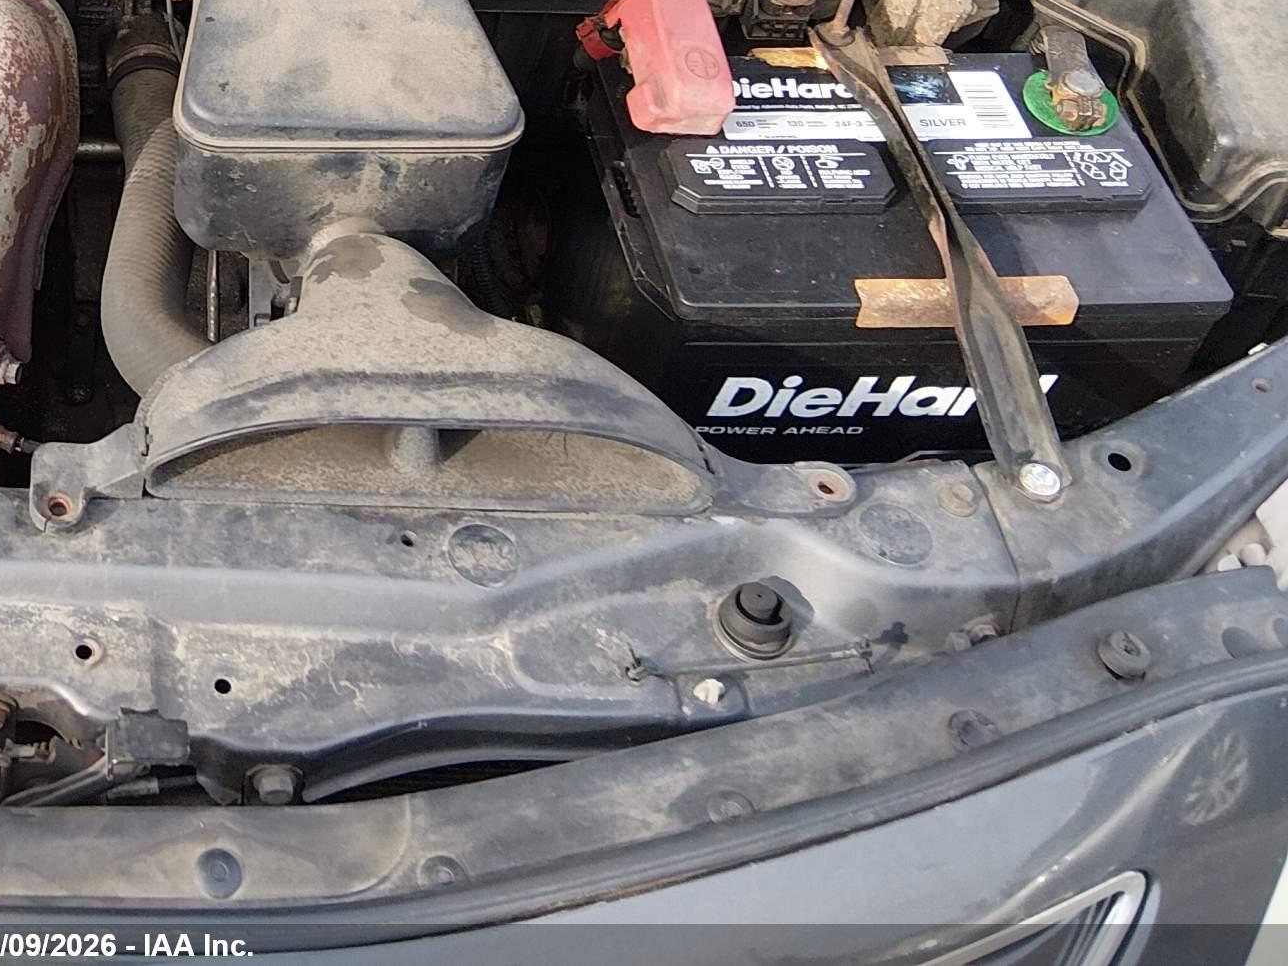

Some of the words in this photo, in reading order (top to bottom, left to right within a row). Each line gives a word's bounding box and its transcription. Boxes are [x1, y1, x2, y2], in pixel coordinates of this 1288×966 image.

[919, 118, 967, 127] SILVER
[719, 145, 776, 154] DANGER
[787, 144, 839, 154] POISON
[695, 426, 776, 435] POWER
[782, 426, 864, 435] AHEAD
